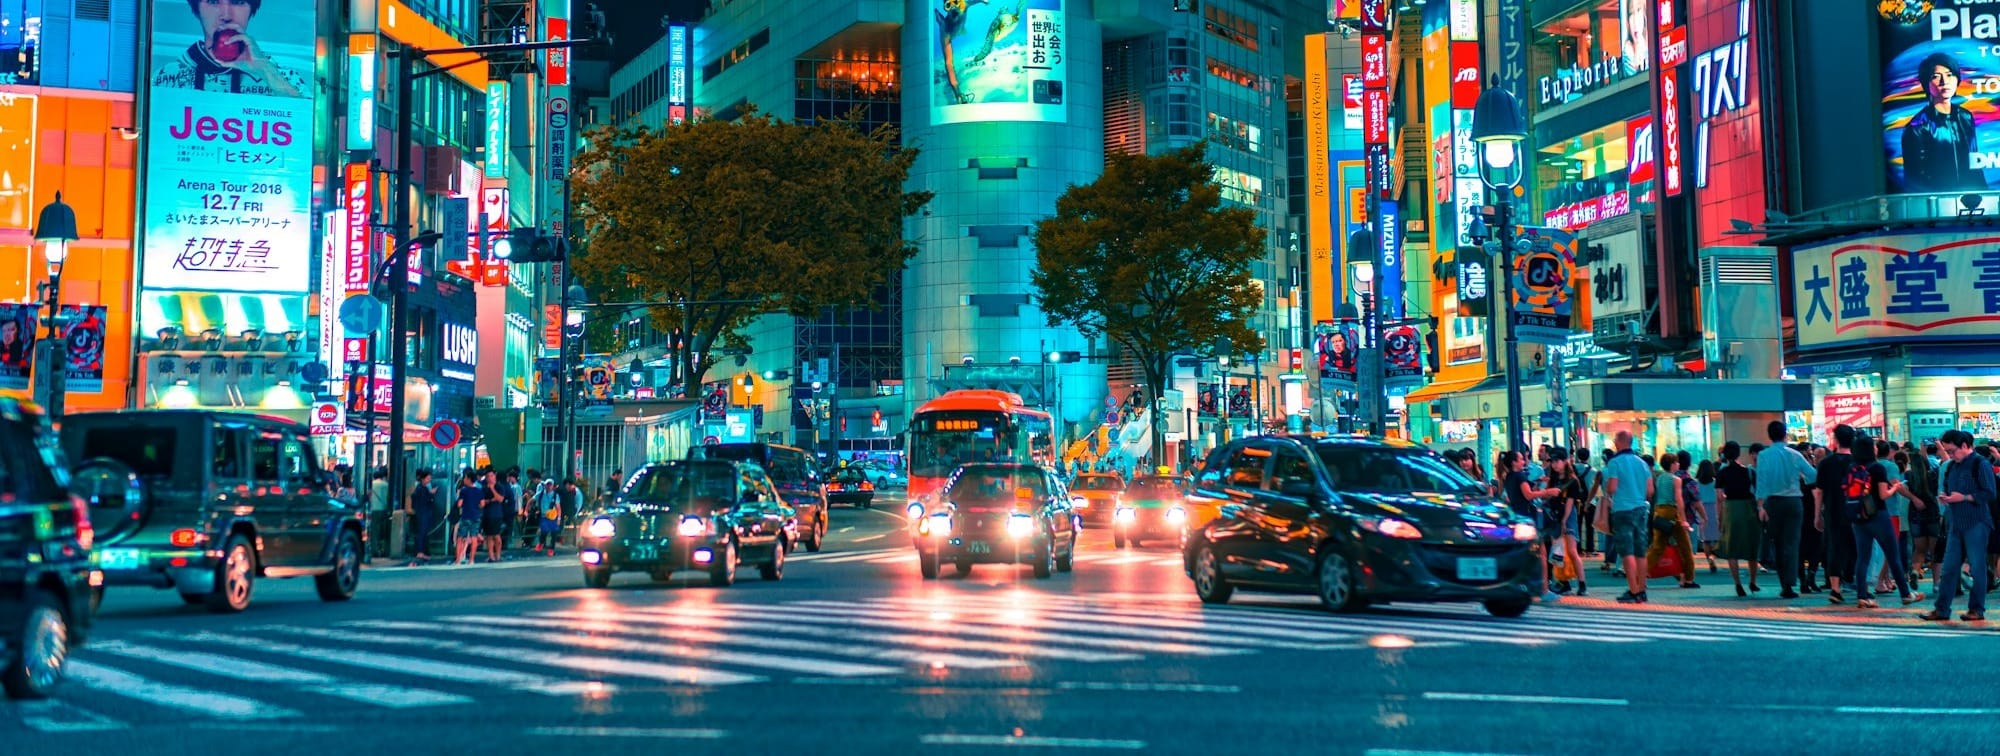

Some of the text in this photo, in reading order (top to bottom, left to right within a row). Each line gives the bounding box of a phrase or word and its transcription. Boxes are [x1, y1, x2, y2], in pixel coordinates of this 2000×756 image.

[1032, 22, 1061, 33] 世界に
[1931, 8, 2000, 41] Pla
[1455, 68, 1477, 83] JTB
[1540, 51, 1619, 104] Euphoria
[1693, 38, 1748, 119] クスリ
[169, 106, 292, 146] Jesus
[242, 107, 293, 118] NEW SINGLE
[1458, 129, 1467, 161] パーラー
[178, 179, 282, 194] Arena Tour 2018
[201, 194, 263, 212] 12.7 FRI
[165, 213, 291, 229] さいたまスーパーアリーナ
[1460, 197, 1470, 231] フルーツ
[173, 237, 279, 272] 超特急
[350, 199, 366, 283] サンドラッグ
[1383, 214, 1395, 266] MIZUHO
[1465, 262, 1486, 299] HUB
[1527, 316, 1557, 327] Tik Tok
[444, 323, 476, 365] LUSH
